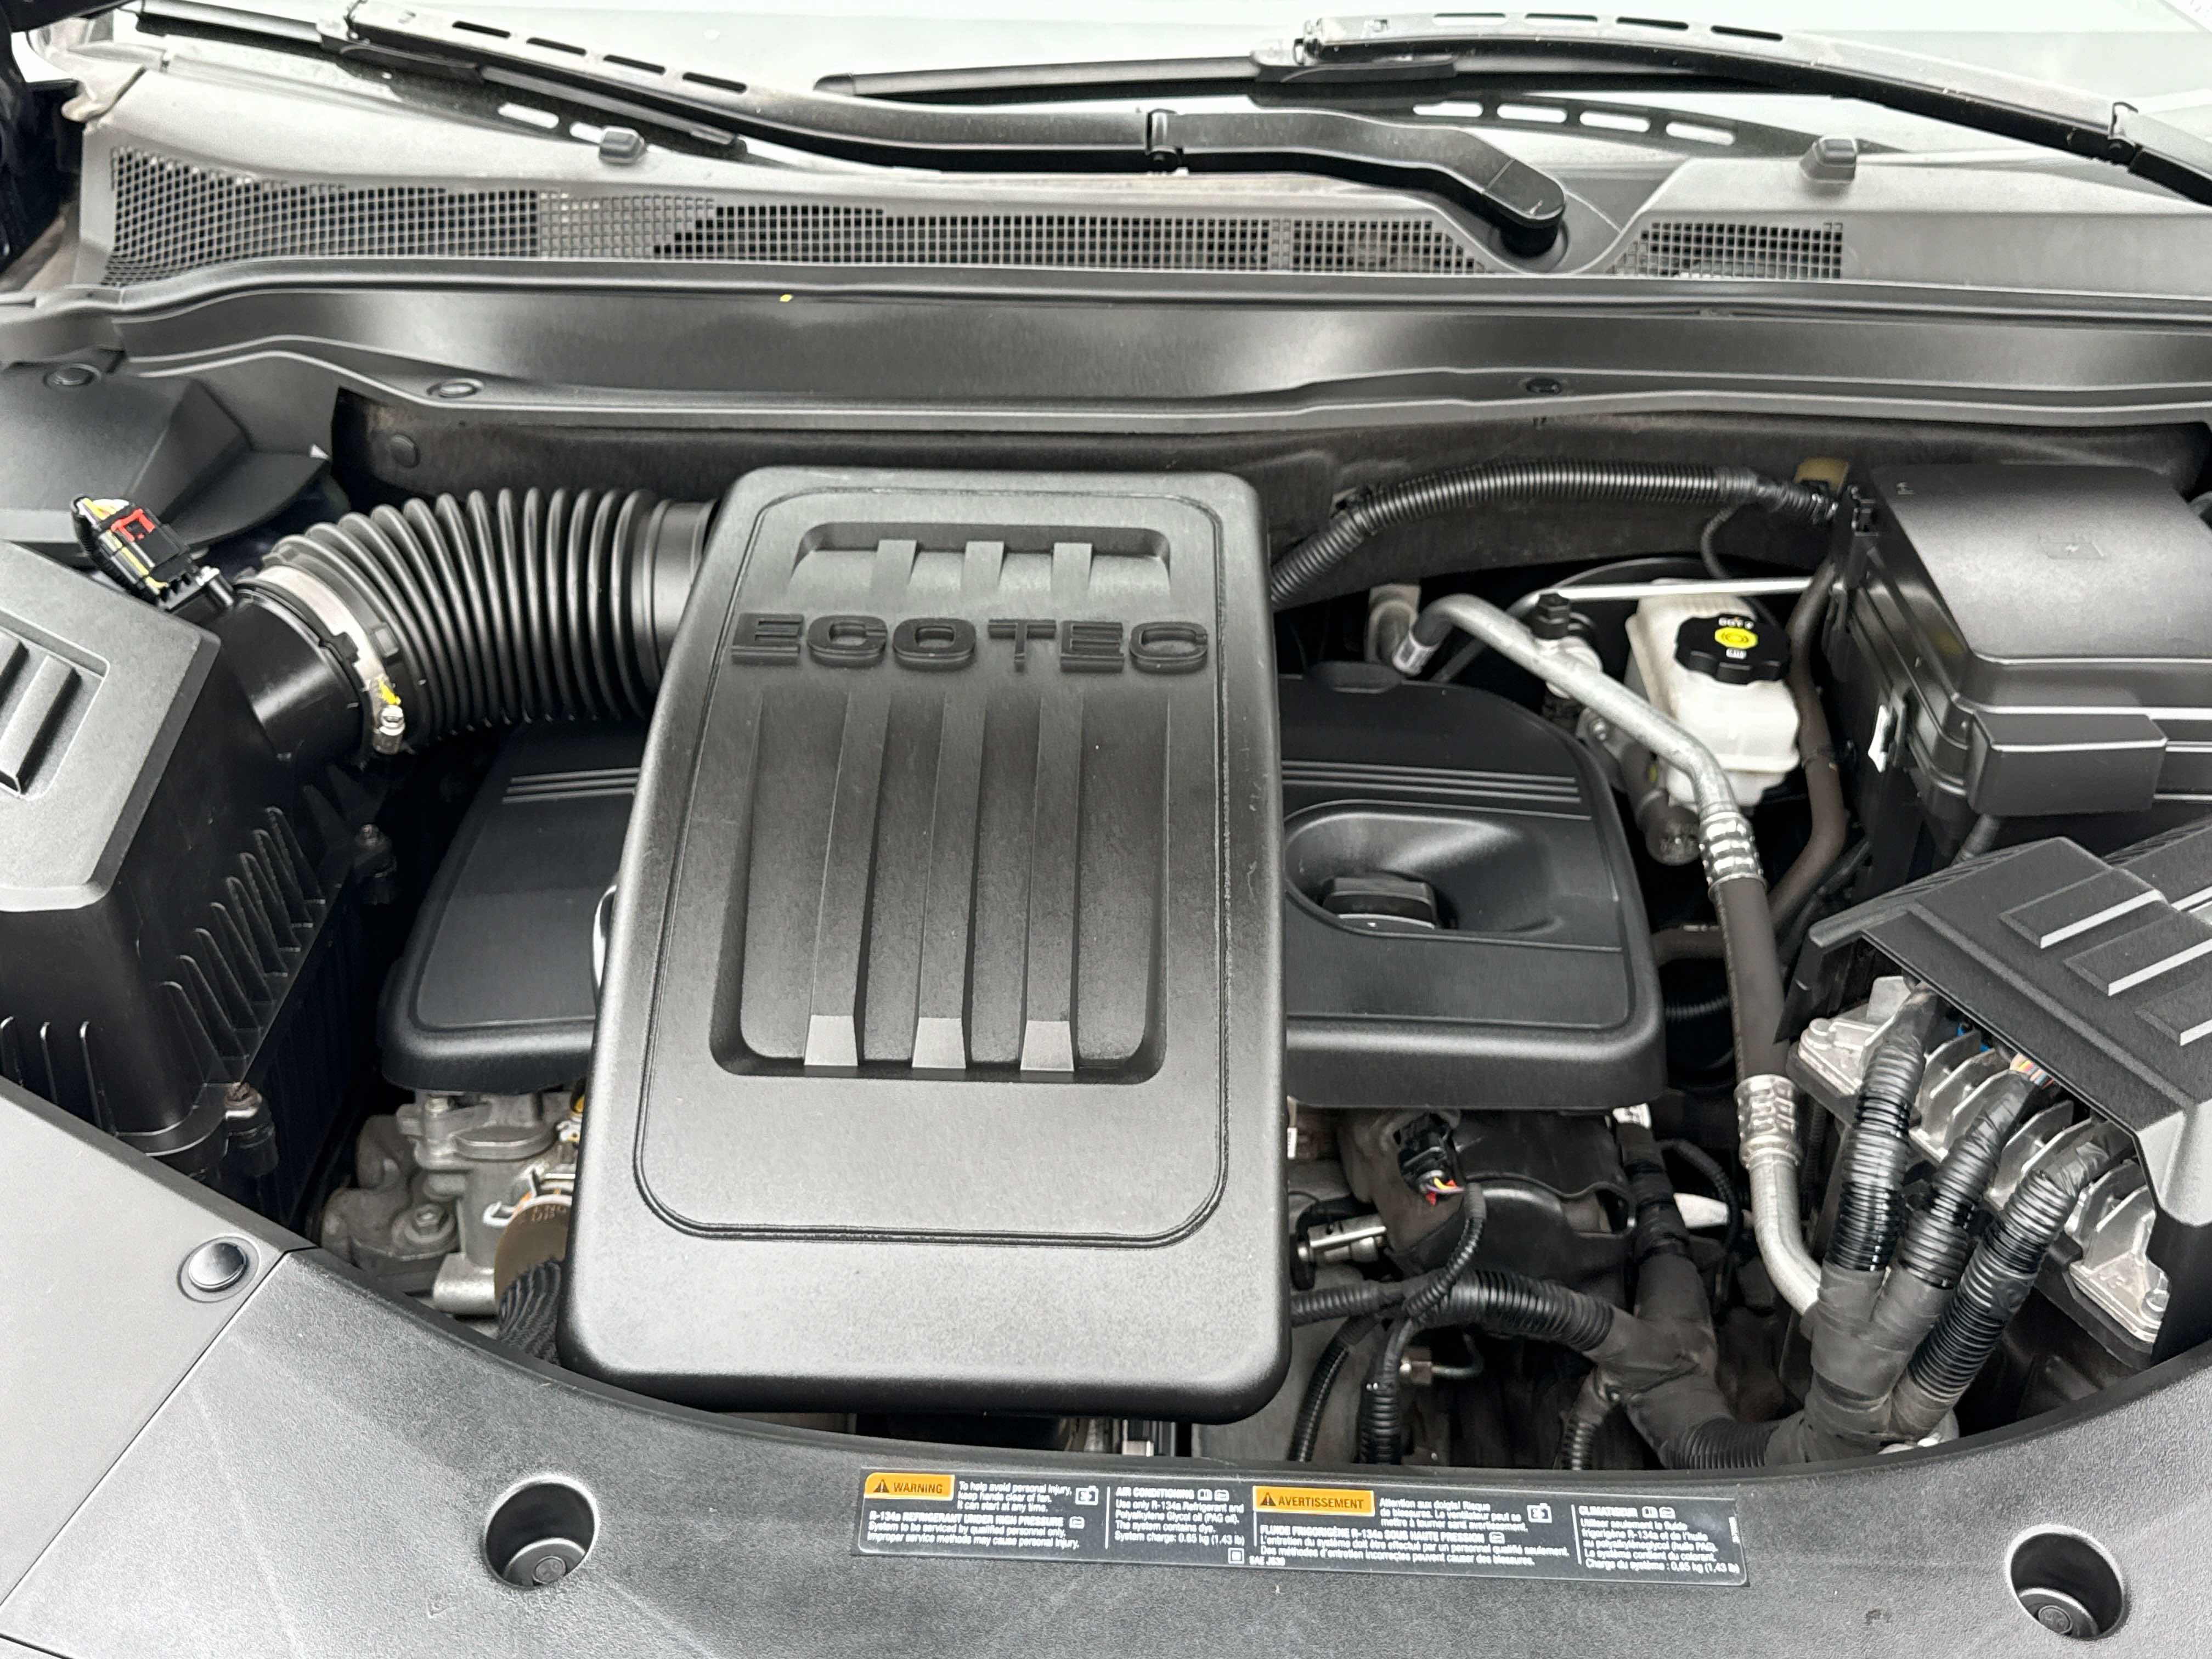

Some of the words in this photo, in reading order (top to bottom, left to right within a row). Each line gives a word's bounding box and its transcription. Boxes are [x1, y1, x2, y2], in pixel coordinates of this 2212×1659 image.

[730, 611, 1208, 673] ECOTEC
[893, 1482, 943, 1494] WARNING
[1133, 1487, 1195, 1499] CONDITIONING
[957, 1499, 963, 1510] It
[964, 1502, 980, 1510] can
[981, 1501, 1001, 1511] start
[1002, 1502, 1011, 1511] at
[1012, 1503, 1026, 1513] any
[1028, 1503, 1048, 1513] time.
[1116, 1499, 1132, 1509] Use
[1133, 1500, 1150, 1511] only
[1152, 1500, 1182, 1511] R-134a
[1183, 1501, 1228, 1513] Refrigerant
[1229, 1503, 1245, 1513] and
[1278, 1496, 1364, 1509] AVERTISSEMENT
[1167, 1511, 1192, 1522] Glycol
[1193, 1513, 1203, 1522] oil
[1205, 1513, 1224, 1523] (PAG
[1116, 1520, 1131, 1530] The
[1133, 1521, 1161, 1532] system
[1163, 1522, 1198, 1532] contains
[1199, 1523, 1216, 1534] dye.
[1115, 1530, 1146, 1542] System
[1199, 1534, 1210, 1546] kg
[1234, 1535, 1245, 1547] lb)
[1305, 1537, 1316, 1547] du
[1584, 1548, 1596, 1558] Le
[1668, 1551, 1680, 1561] du
[1617, 1559, 1629, 1570] du
[1692, 1562, 1705, 1574] kg
